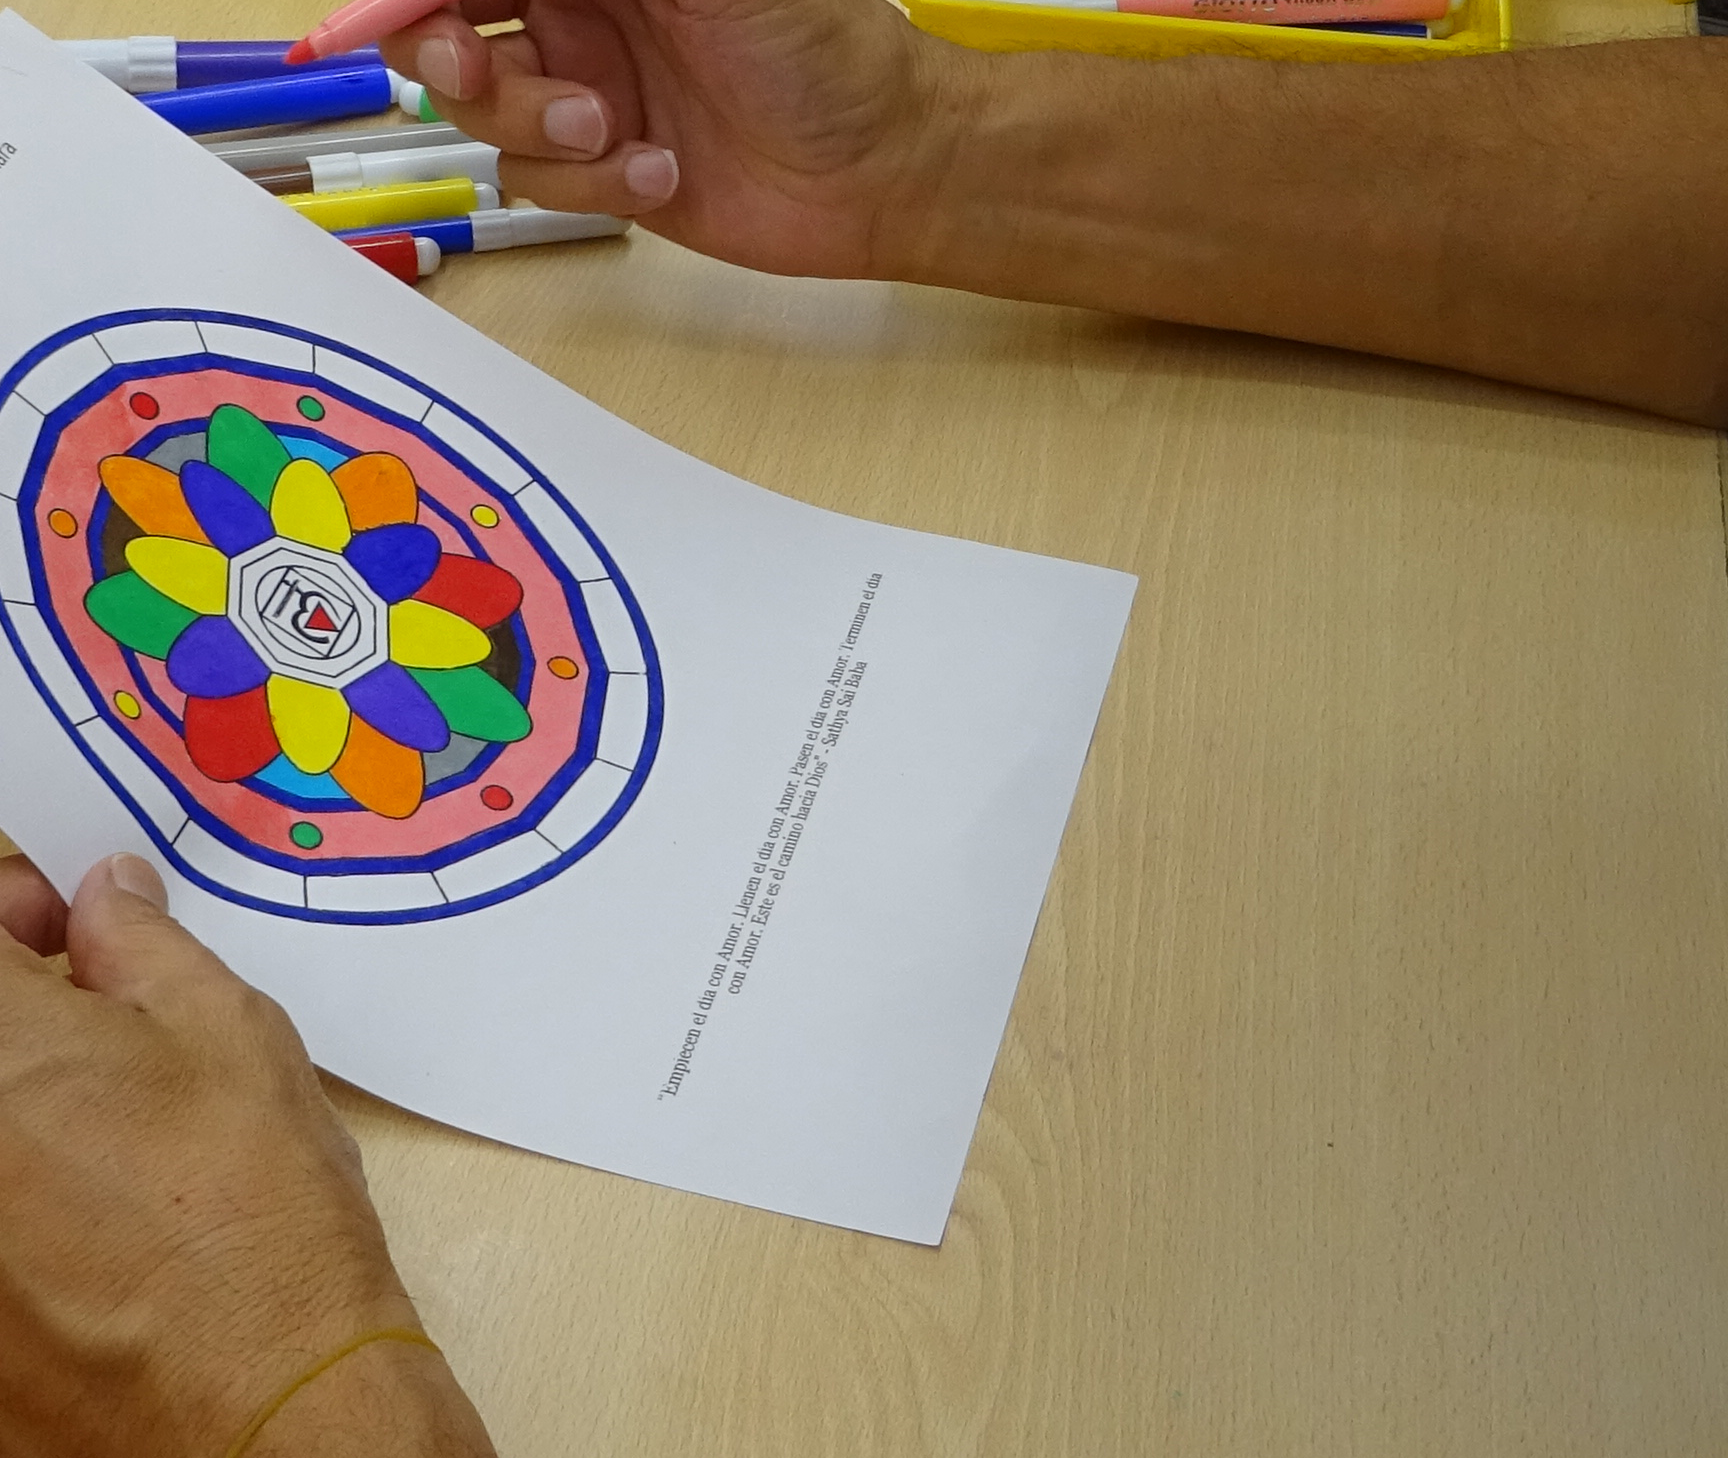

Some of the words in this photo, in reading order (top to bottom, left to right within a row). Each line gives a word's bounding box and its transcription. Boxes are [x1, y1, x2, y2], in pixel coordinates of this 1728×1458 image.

[861, 589, 876, 601] el
[838, 601, 872, 651] Terminen
[826, 654, 851, 689] Amor.
[843, 661, 869, 689] Baba
[818, 689, 837, 710] con
[836, 688, 857, 708] Sai
[805, 729, 821, 741] el
[820, 709, 850, 748] Sathya
[788, 742, 815, 778] Pasen
[774, 779, 801, 817] Amor.
[789, 789, 818, 822] hacia
[767, 817, 786, 839] con
[777, 822, 805, 868] camino
[751, 861, 768, 874] el
[768, 867, 787, 881] el
[731, 876, 763, 919] Llenen
[766, 882, 782, 897] es
[749, 897, 776, 927] Este
[715, 921, 745, 963] Amor.
[734, 929, 764, 970] Amor.
[707, 963, 728, 987] con
[727, 970, 747, 995] con
[692, 1011, 708, 1026] el
